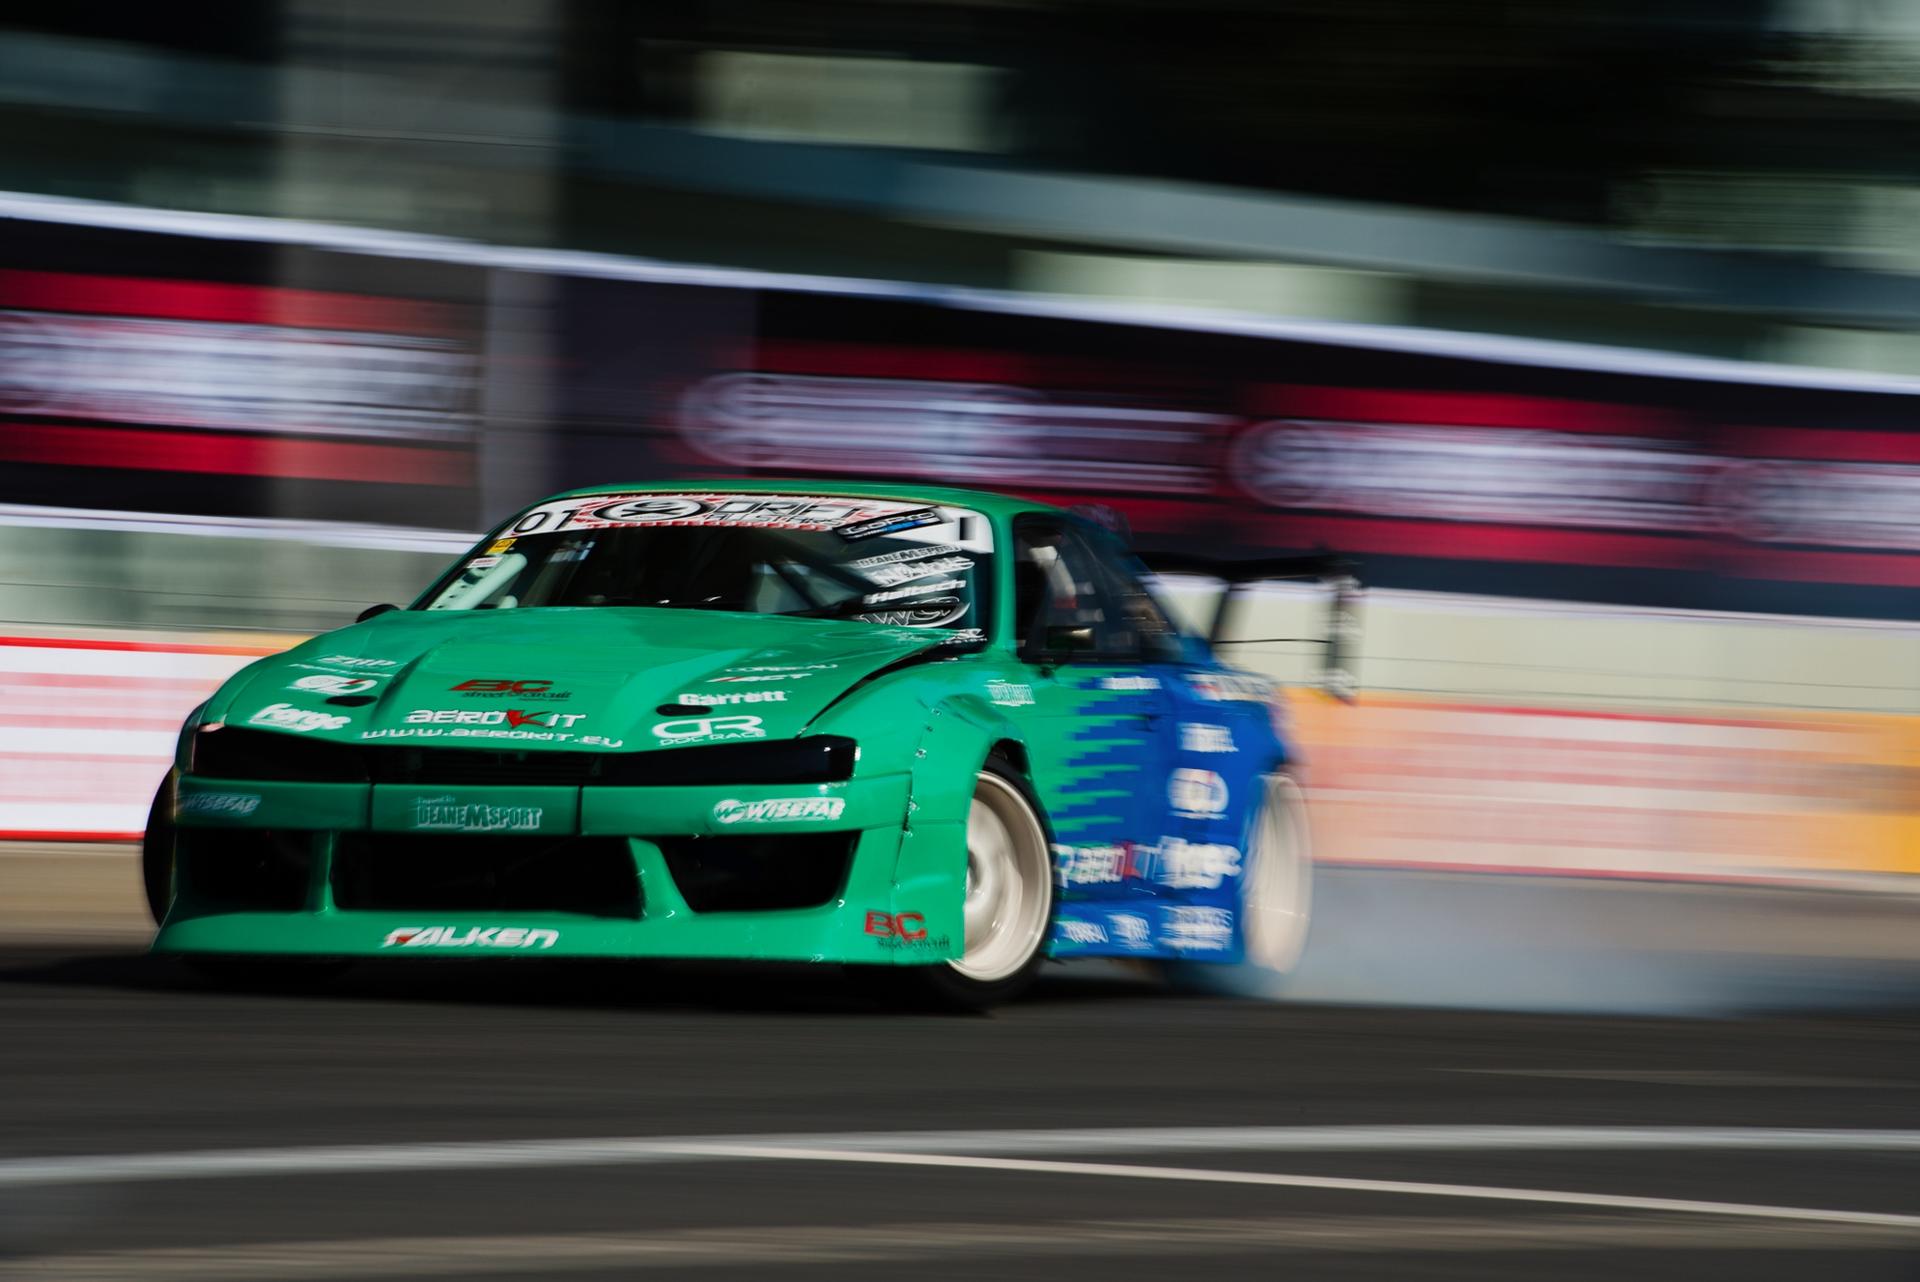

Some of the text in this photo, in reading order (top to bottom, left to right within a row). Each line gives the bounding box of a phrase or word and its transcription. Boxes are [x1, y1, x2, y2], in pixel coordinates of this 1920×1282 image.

[513, 509, 581, 533] 01
[450, 679, 554, 693] BC
[678, 690, 788, 706] Garrett
[708, 731, 768, 742] RACE
[863, 910, 928, 942] BC
[382, 926, 560, 950] FALKEN
